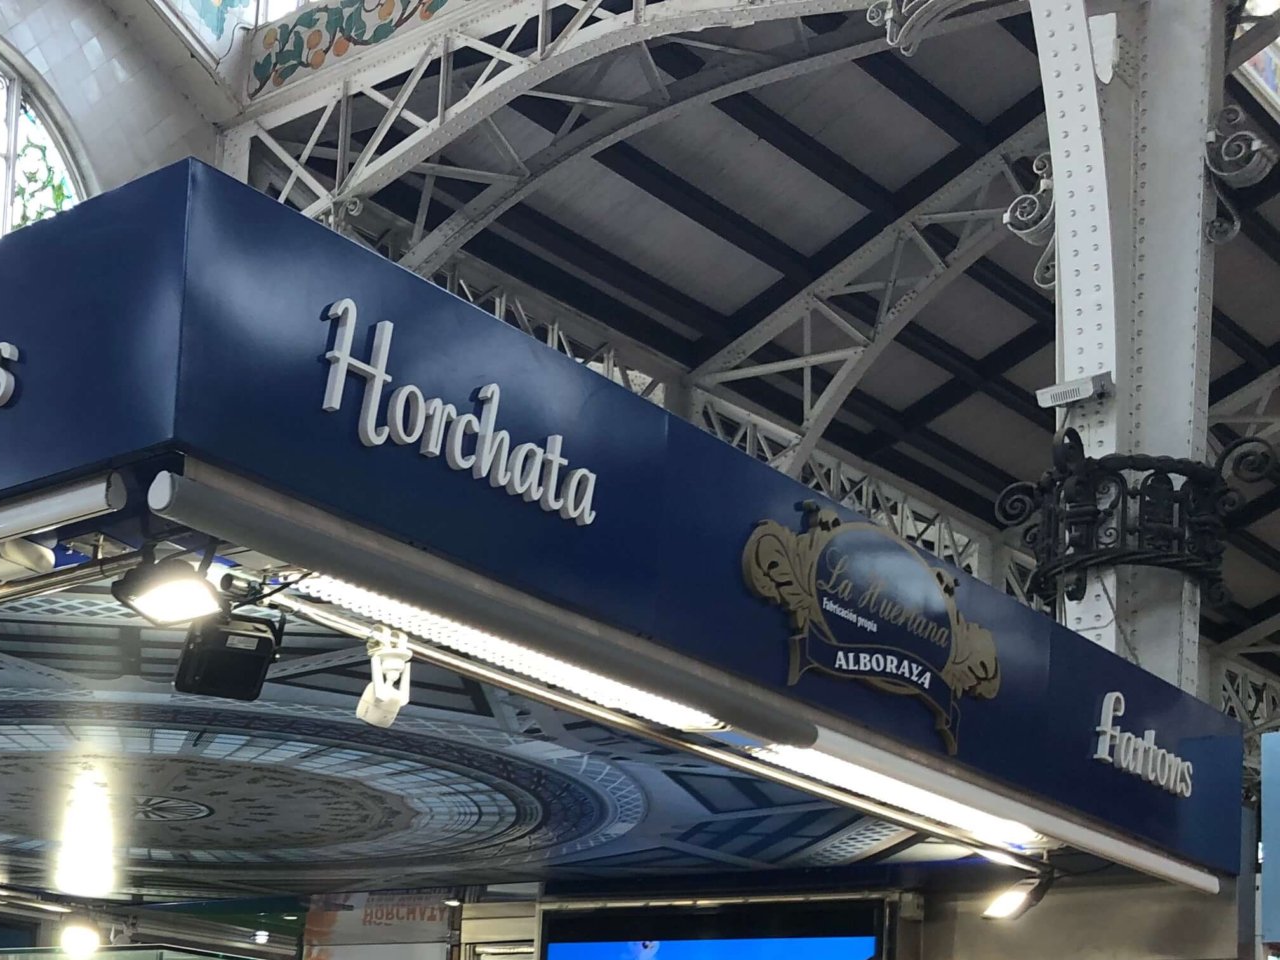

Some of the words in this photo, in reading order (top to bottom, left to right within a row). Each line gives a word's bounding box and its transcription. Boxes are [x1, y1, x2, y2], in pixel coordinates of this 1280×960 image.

[322, 298, 597, 526] Horchata
[834, 650, 932, 689] ALBORAYA
[1093, 692, 1193, 798] fartons
